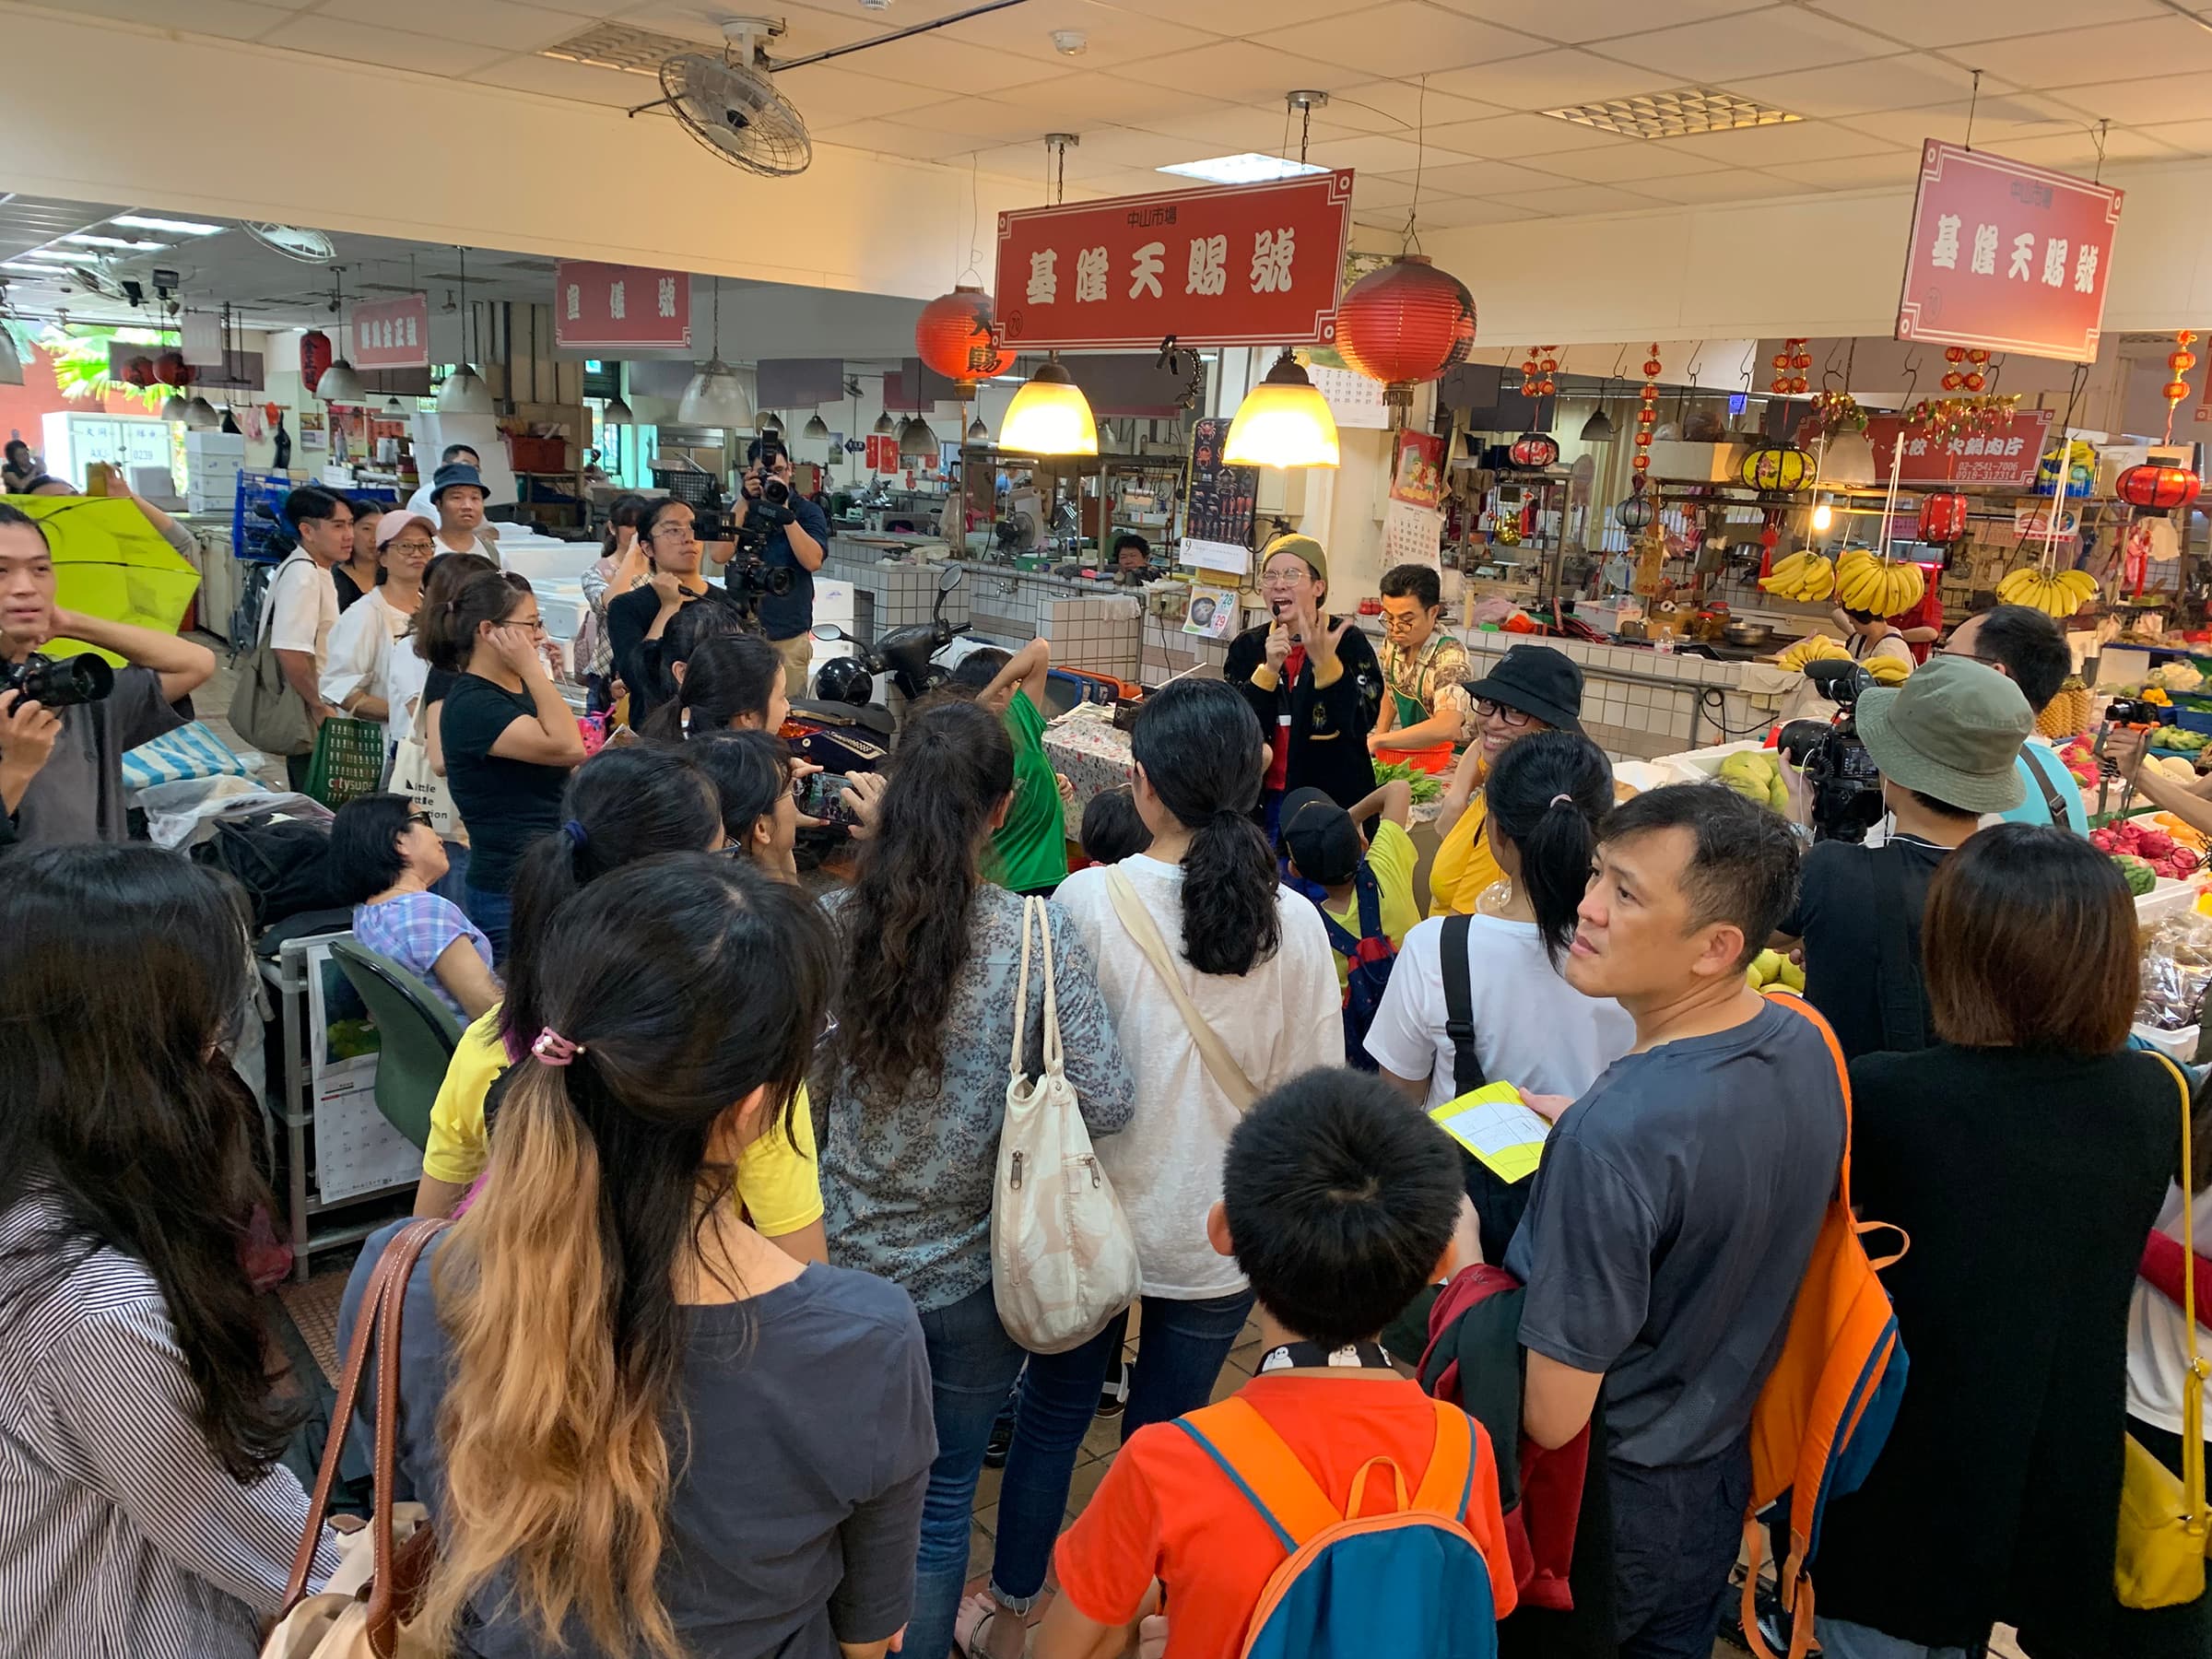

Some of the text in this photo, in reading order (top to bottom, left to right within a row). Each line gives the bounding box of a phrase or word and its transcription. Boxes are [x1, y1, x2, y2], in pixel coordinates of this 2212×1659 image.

[1127, 206, 1178, 229] 中山市場
[1932, 213, 2100, 294] 基隆天賜號
[1026, 227, 1296, 305] 基隆天賜號
[1185, 539, 1192, 552] 9
[1222, 594, 1234, 606] 28
[1215, 615, 1227, 627] 29
